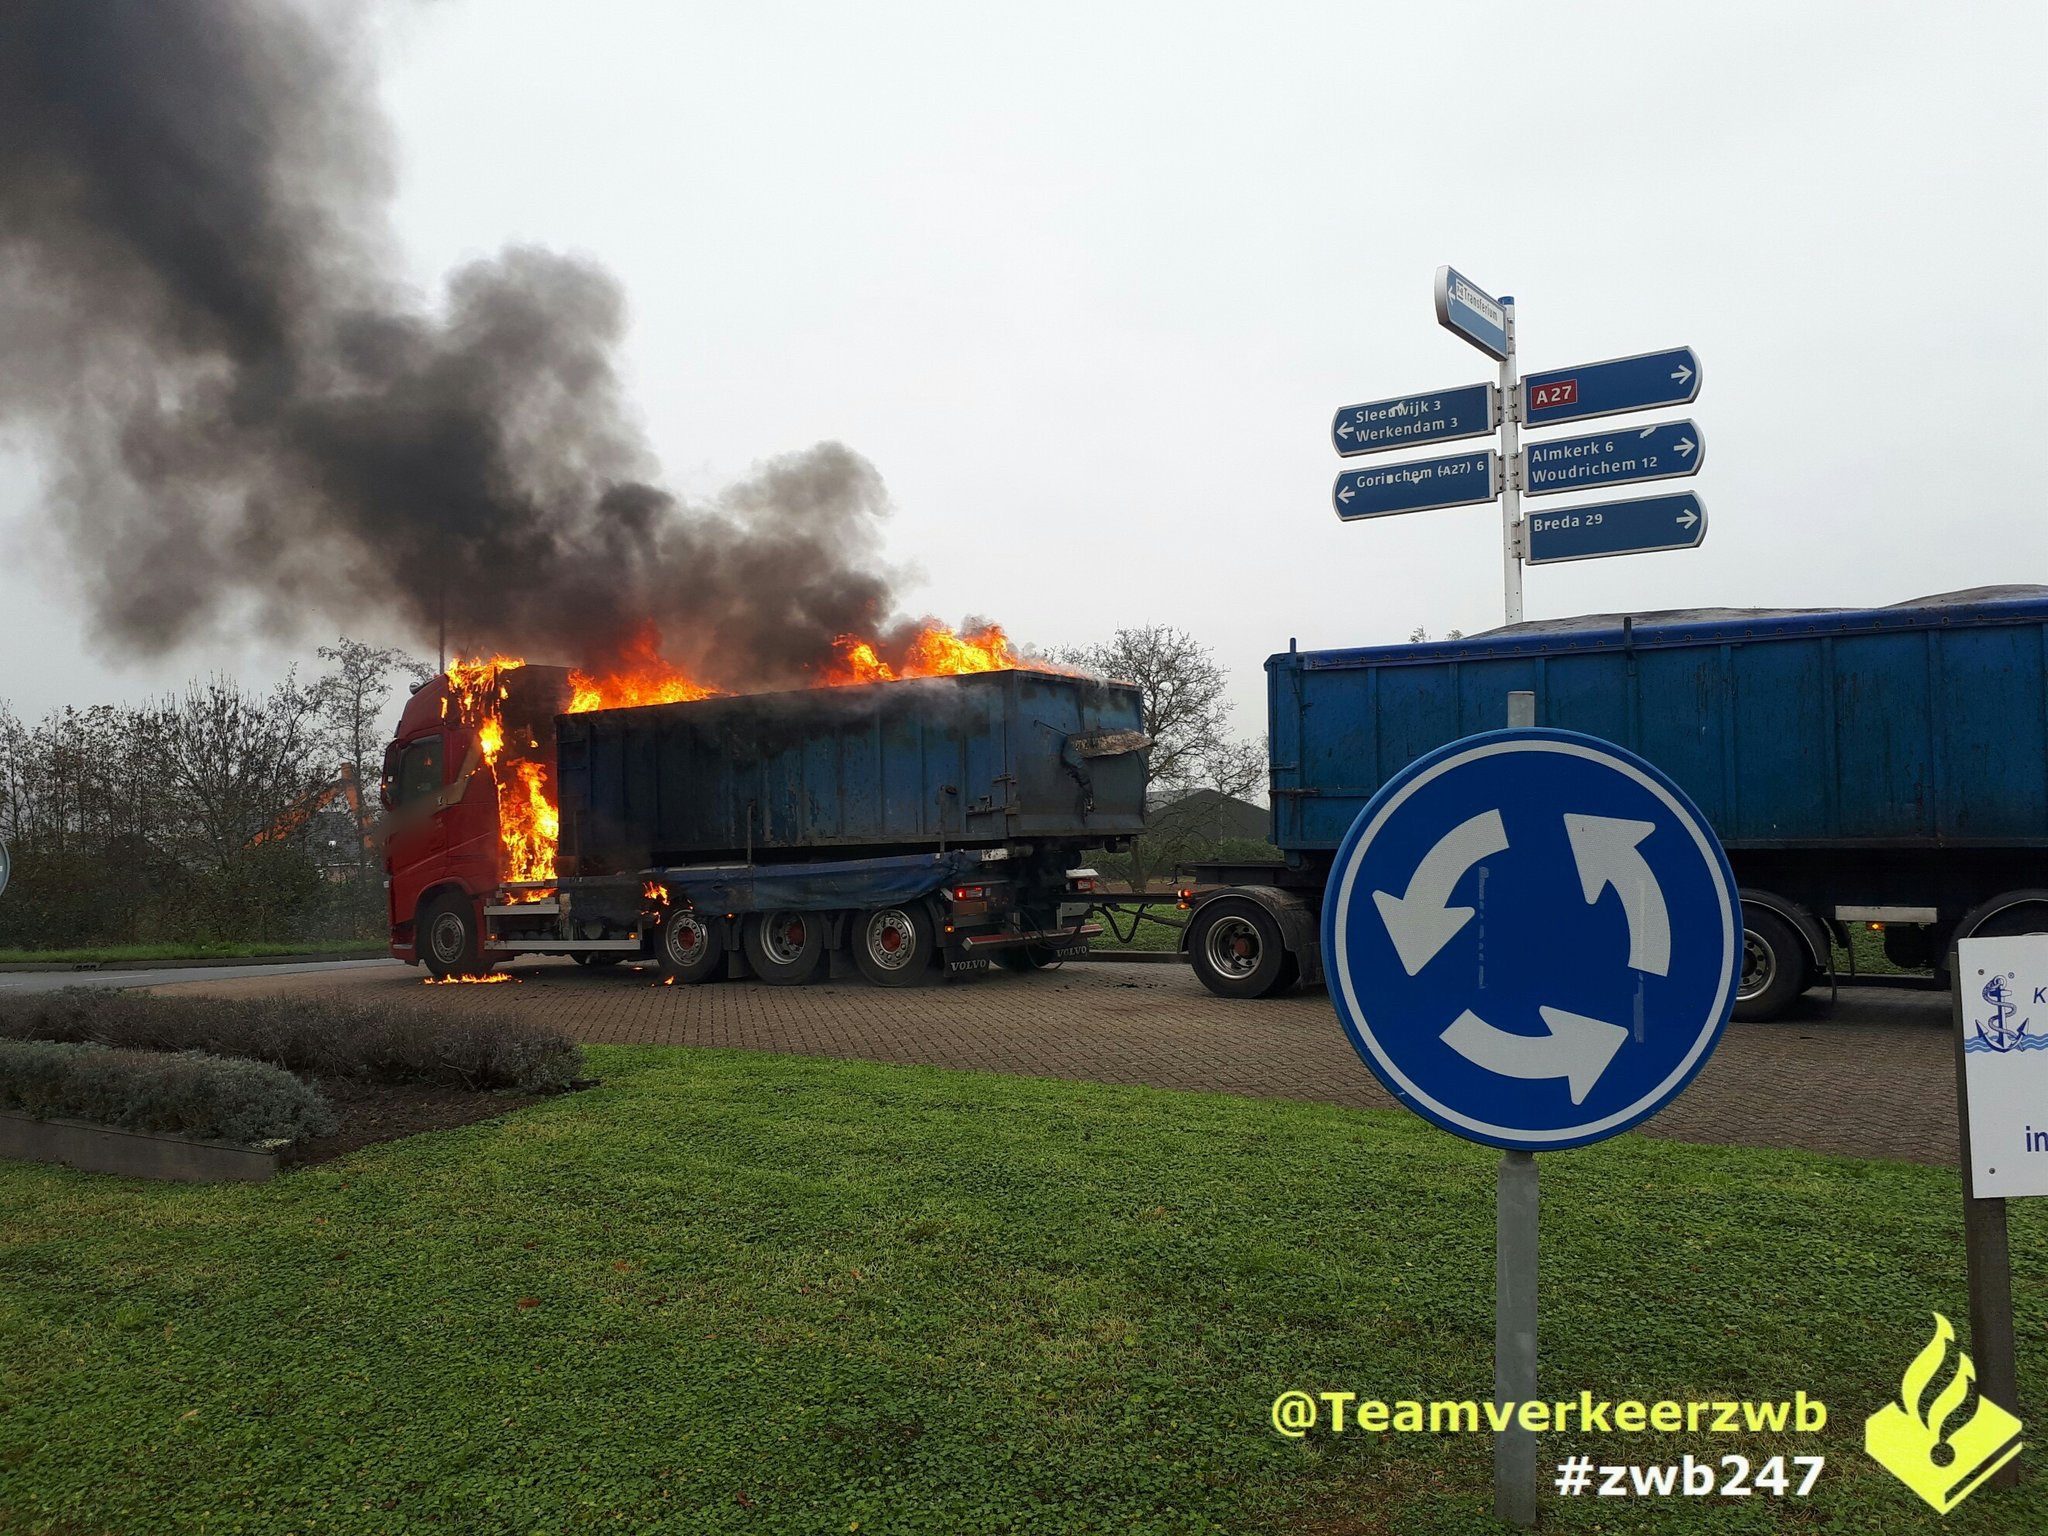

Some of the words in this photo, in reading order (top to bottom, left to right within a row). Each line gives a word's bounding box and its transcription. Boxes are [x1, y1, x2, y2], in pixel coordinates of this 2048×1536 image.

[1464, 286, 1498, 322] Transferium
[1536, 385, 1573, 405] A27
[1433, 400, 1441, 411] 3
[1356, 418, 1445, 443] Werkendam
[1450, 417, 1458, 428] 3
[1532, 441, 1600, 463] Almkerk
[1605, 441, 1614, 453] 6
[1437, 461, 1471, 478] (A27)
[1476, 460, 1485, 472] 6
[1532, 459, 1636, 484] Woudrichem
[1641, 456, 1658, 469] 12
[1533, 515, 1580, 532] Breda
[1585, 513, 1603, 526] 29
[1056, 945, 1088, 958] VOLVO
[950, 959, 987, 972] VOLVO
